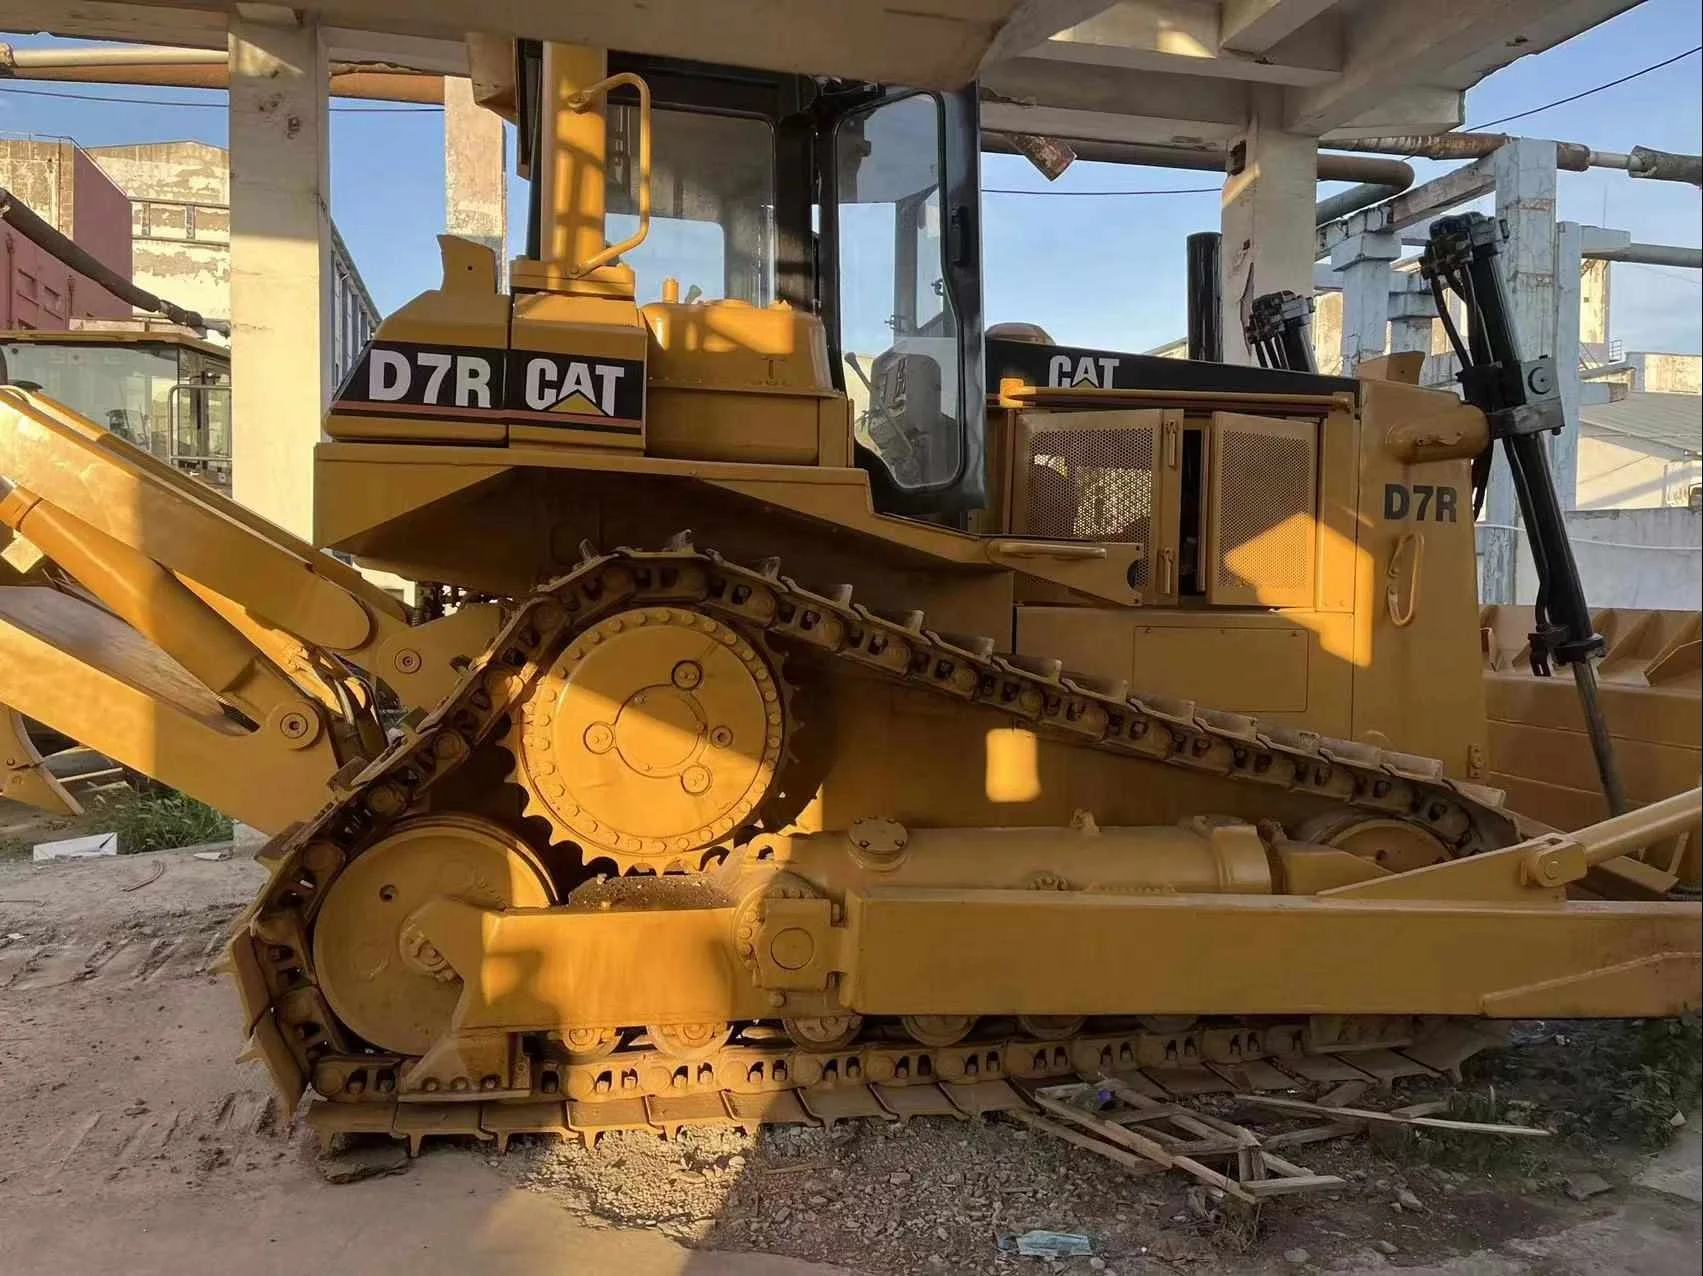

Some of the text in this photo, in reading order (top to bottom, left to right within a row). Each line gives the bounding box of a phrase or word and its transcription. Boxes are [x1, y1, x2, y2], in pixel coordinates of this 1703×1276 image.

[368, 349, 624, 417] D7R CAT
[1048, 355, 1120, 389] CAT
[1384, 483, 1457, 523] D7R
